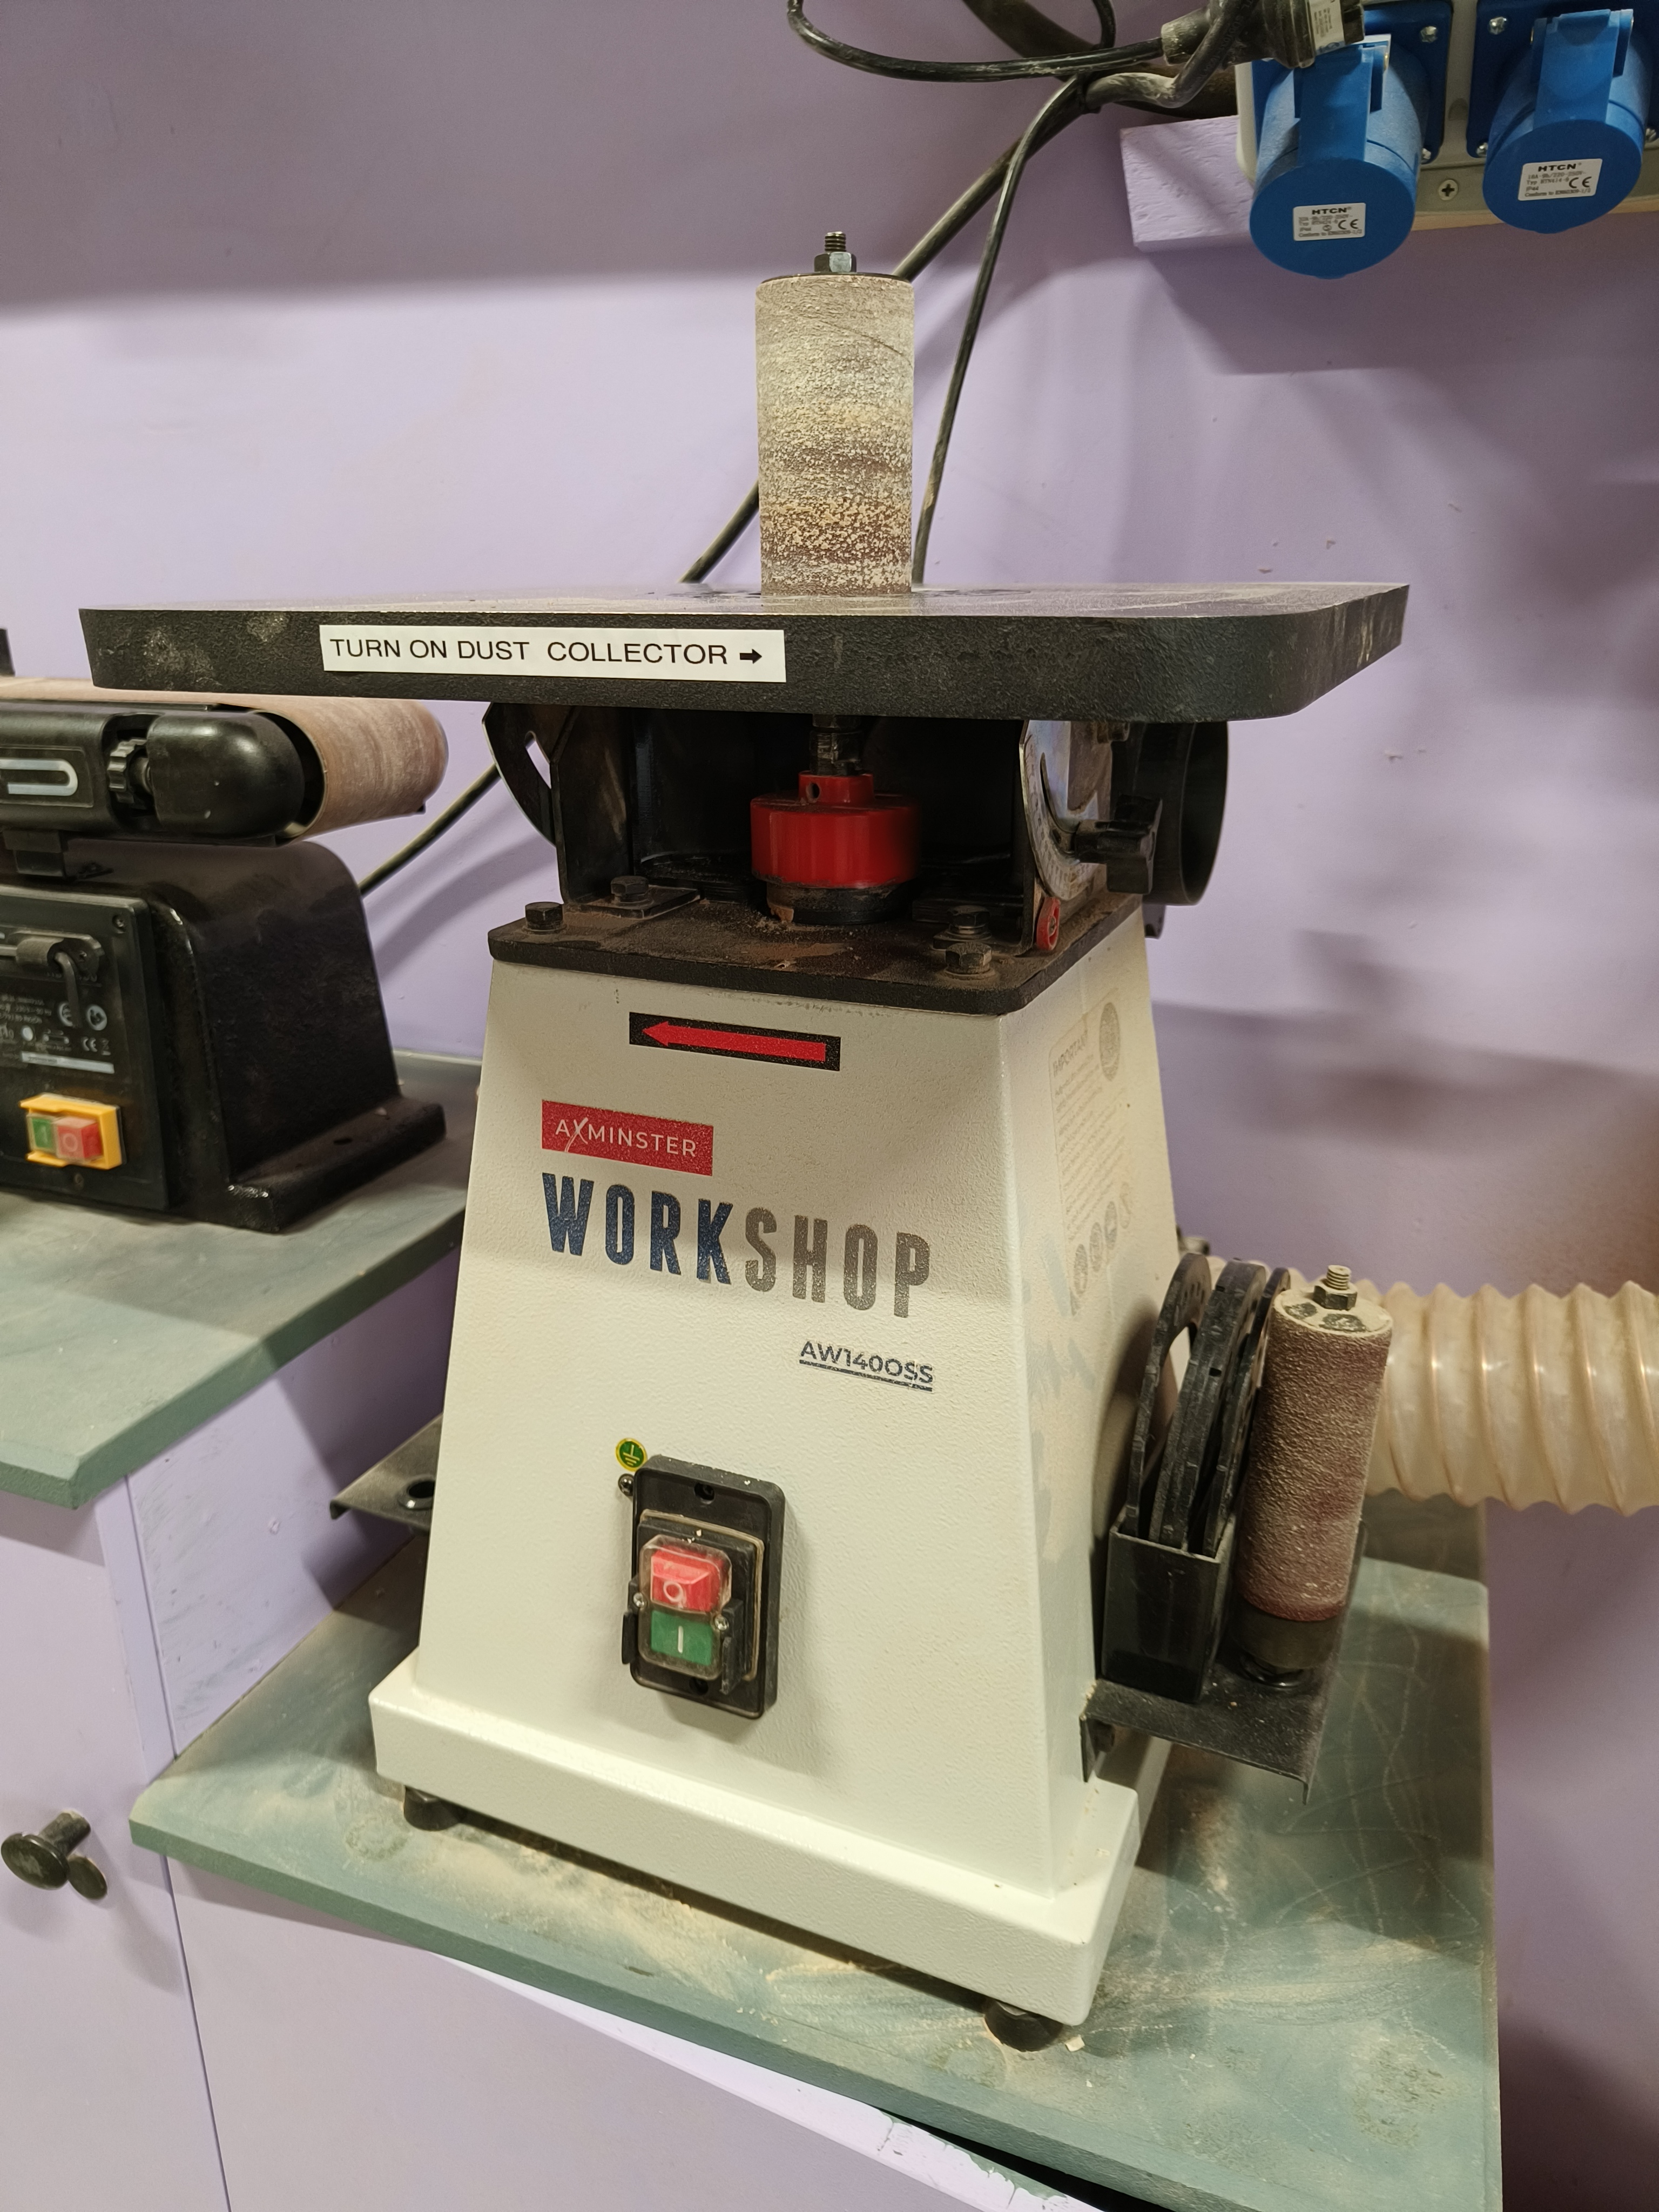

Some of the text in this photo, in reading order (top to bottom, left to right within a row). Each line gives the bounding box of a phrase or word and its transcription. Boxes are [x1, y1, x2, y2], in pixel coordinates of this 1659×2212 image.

[1538, 164, 1576, 172] HTCN
[329, 638, 728, 665] TURN ON DUST COLLECTOR
[555, 1116, 697, 1157] AXMINSTER
[542, 1171, 930, 1318] WORKSHOP
